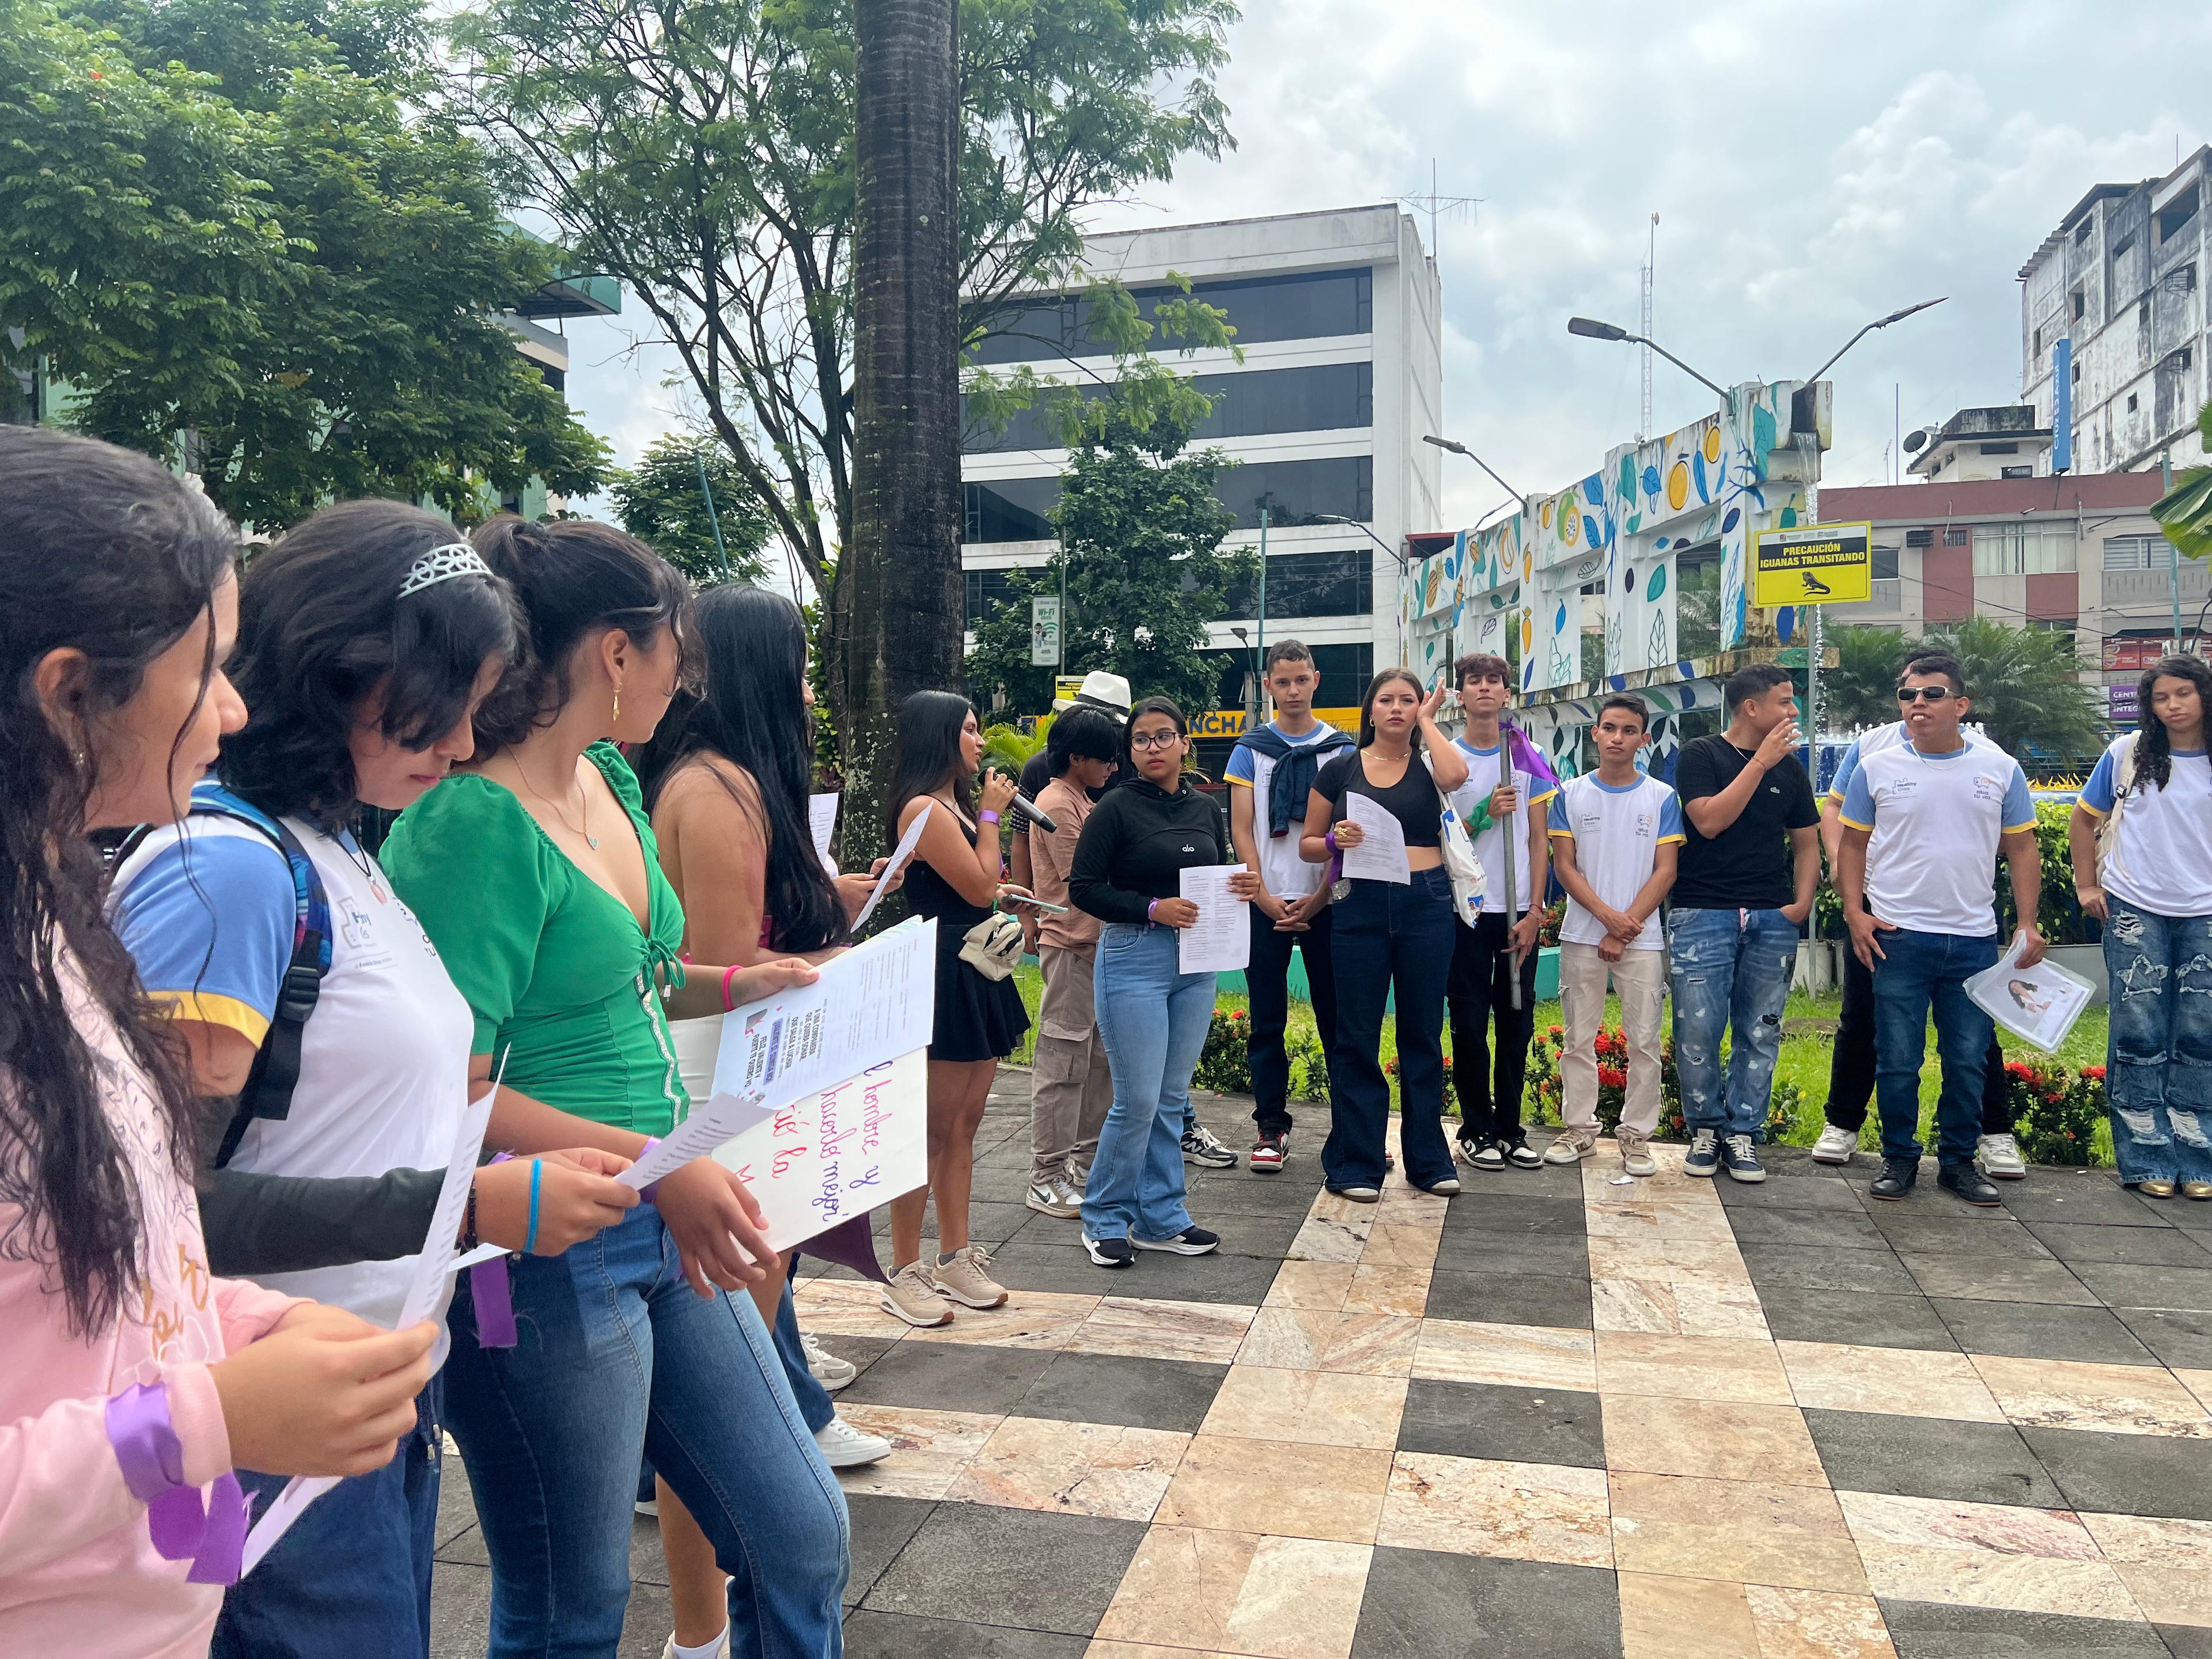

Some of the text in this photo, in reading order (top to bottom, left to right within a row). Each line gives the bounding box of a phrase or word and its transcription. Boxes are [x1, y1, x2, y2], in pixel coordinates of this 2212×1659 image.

[1760, 552, 1865, 568] IGUANAS TRANSITANDO
[1783, 541, 1840, 556] PRECAUCIÓN
[1189, 715, 1247, 734] NCHA
[820, 1082, 857, 1158] hacerlo
[862, 1080, 892, 1155] hombre
[772, 1104, 810, 1179] ció la
[850, 1165, 881, 1188] y
